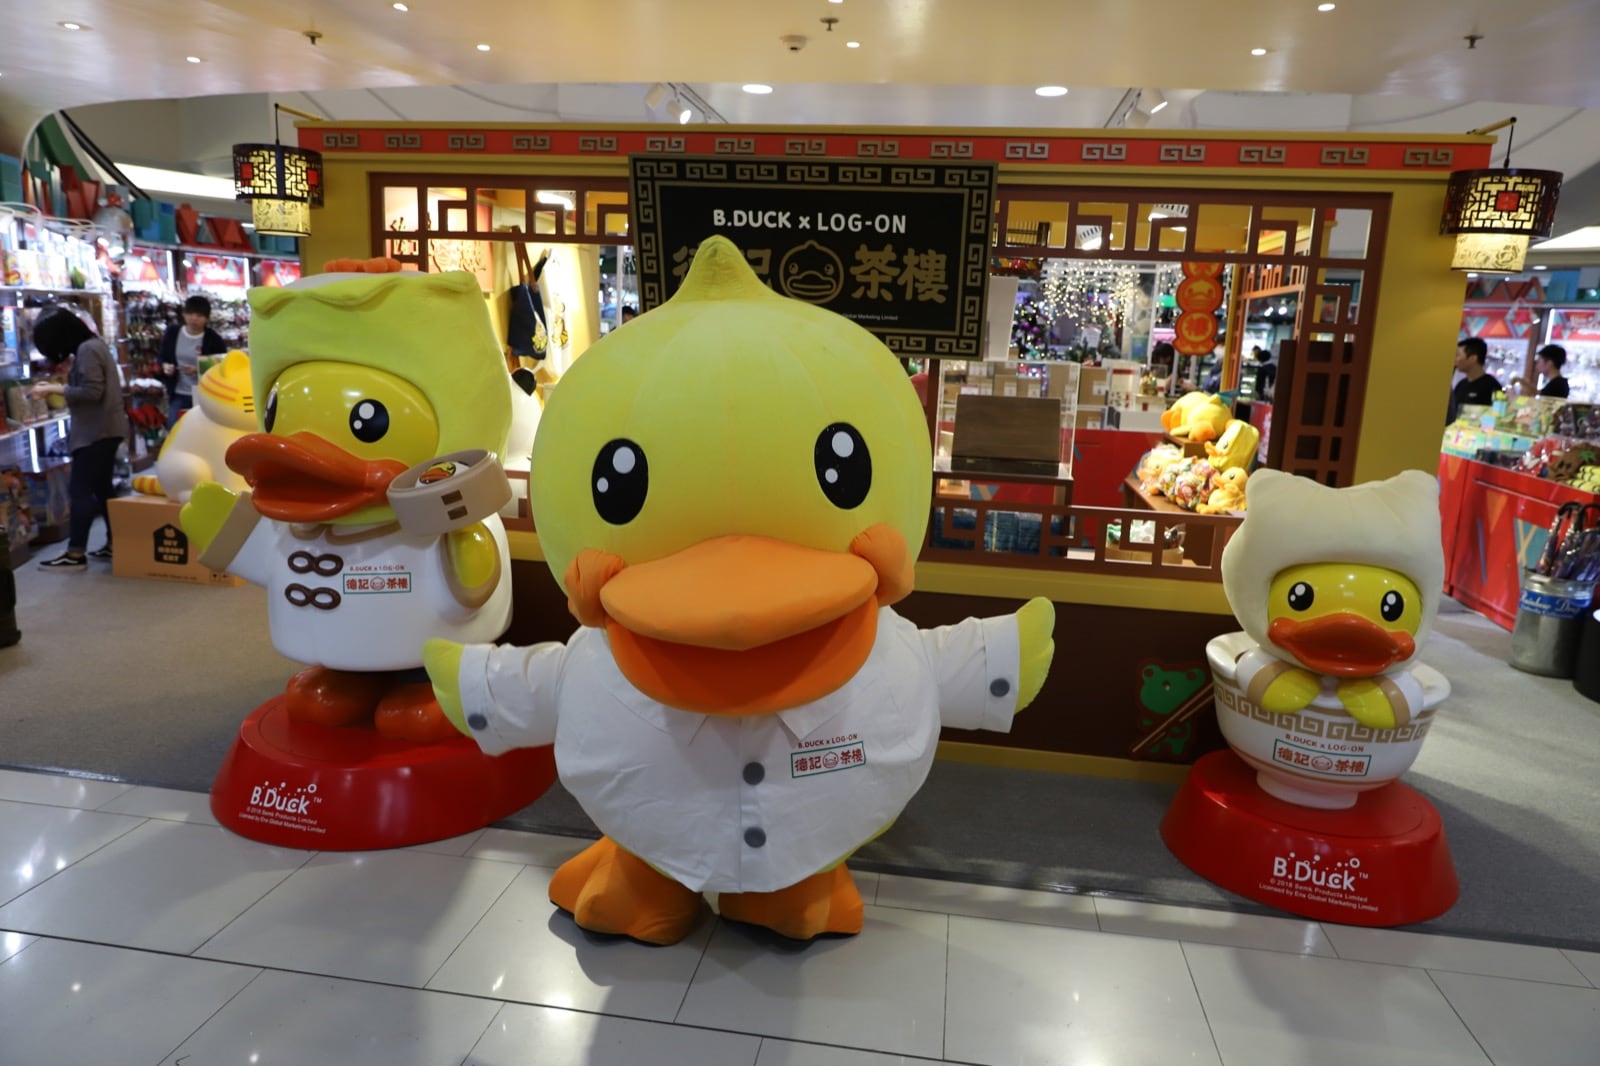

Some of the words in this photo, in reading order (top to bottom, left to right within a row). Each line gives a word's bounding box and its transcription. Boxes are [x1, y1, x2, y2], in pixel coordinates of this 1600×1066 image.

[713, 209, 792, 229] B.DUCK
[798, 215, 811, 230] x
[817, 212, 907, 234] LOG-ON
[850, 243, 949, 304] 茶樓
[798, 740, 824, 749] B.DUCK
[831, 733, 858, 744] LOG-ON
[1285, 733, 1317, 747] B.DUCK
[1328, 743, 1365, 753] LOG-ON
[250, 786, 311, 816] B.Duck
[1273, 856, 1356, 892] B.Duck
[1259, 883, 1285, 894] Licensed
[1328, 897, 1357, 909] Marketing
[1358, 902, 1379, 912] Limited
[1314, 887, 1343, 898] Products
[1344, 893, 1368, 903] Limited
